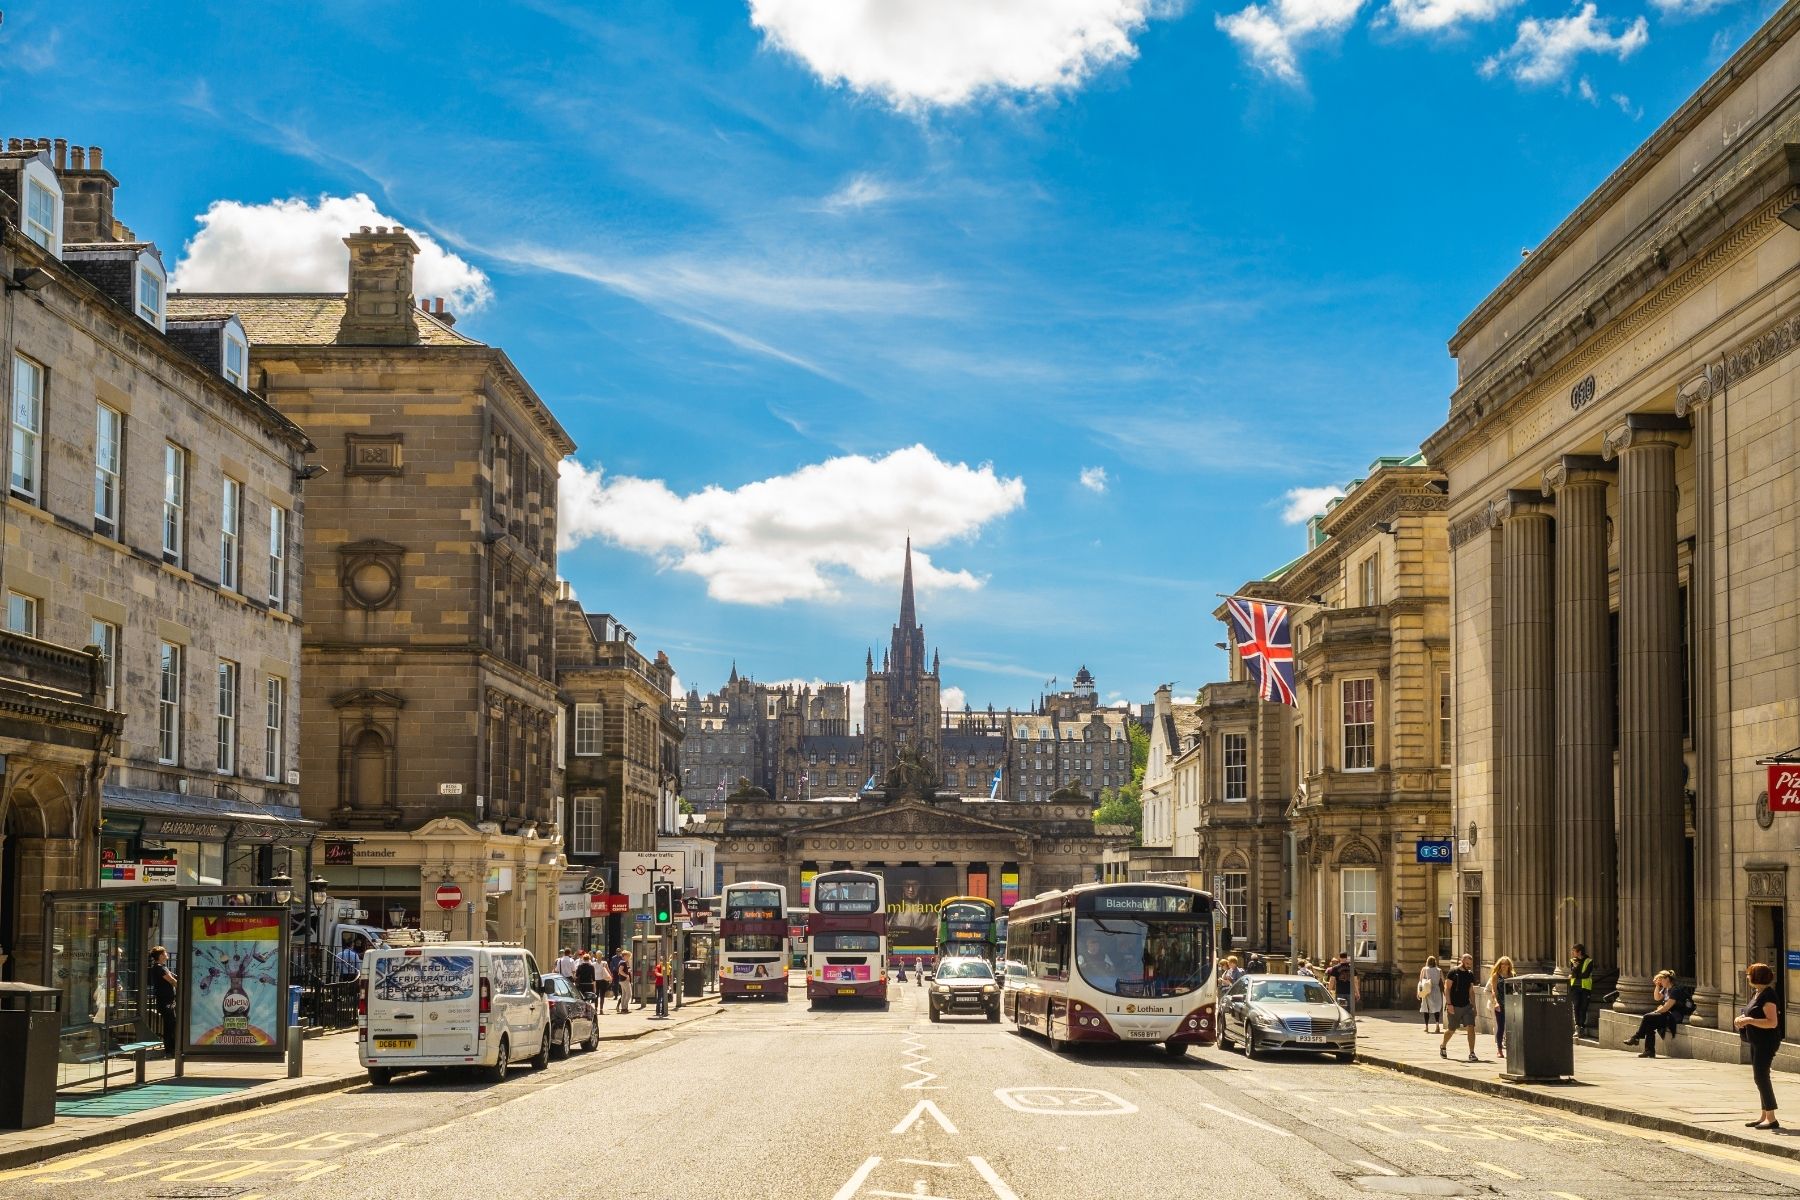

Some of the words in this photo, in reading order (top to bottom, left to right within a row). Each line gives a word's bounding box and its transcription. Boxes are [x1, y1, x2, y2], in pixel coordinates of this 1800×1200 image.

[1776, 772, 1800, 789] Piz
[1782, 790, 1800, 805] Hu
[160, 822, 195, 835] BEARFORD
[195, 824, 217, 836] HOUSE
[353, 848, 396, 858] Santander
[1423, 848, 1447, 856] TSB
[825, 903, 834, 911] 41
[887, 899, 943, 913] mbrand
[1106, 898, 1149, 909] Blackhall
[1168, 898, 1186, 911] 42
[733, 911, 741, 919] 27
[224, 997, 249, 1009] Ribena
[1137, 1005, 1164, 1013] Lothian
[379, 1040, 397, 1048] DC66
[399, 1040, 412, 1048] TTV
[180, 1131, 379, 1151] BUS
[31, 1159, 323, 1184] STOP
